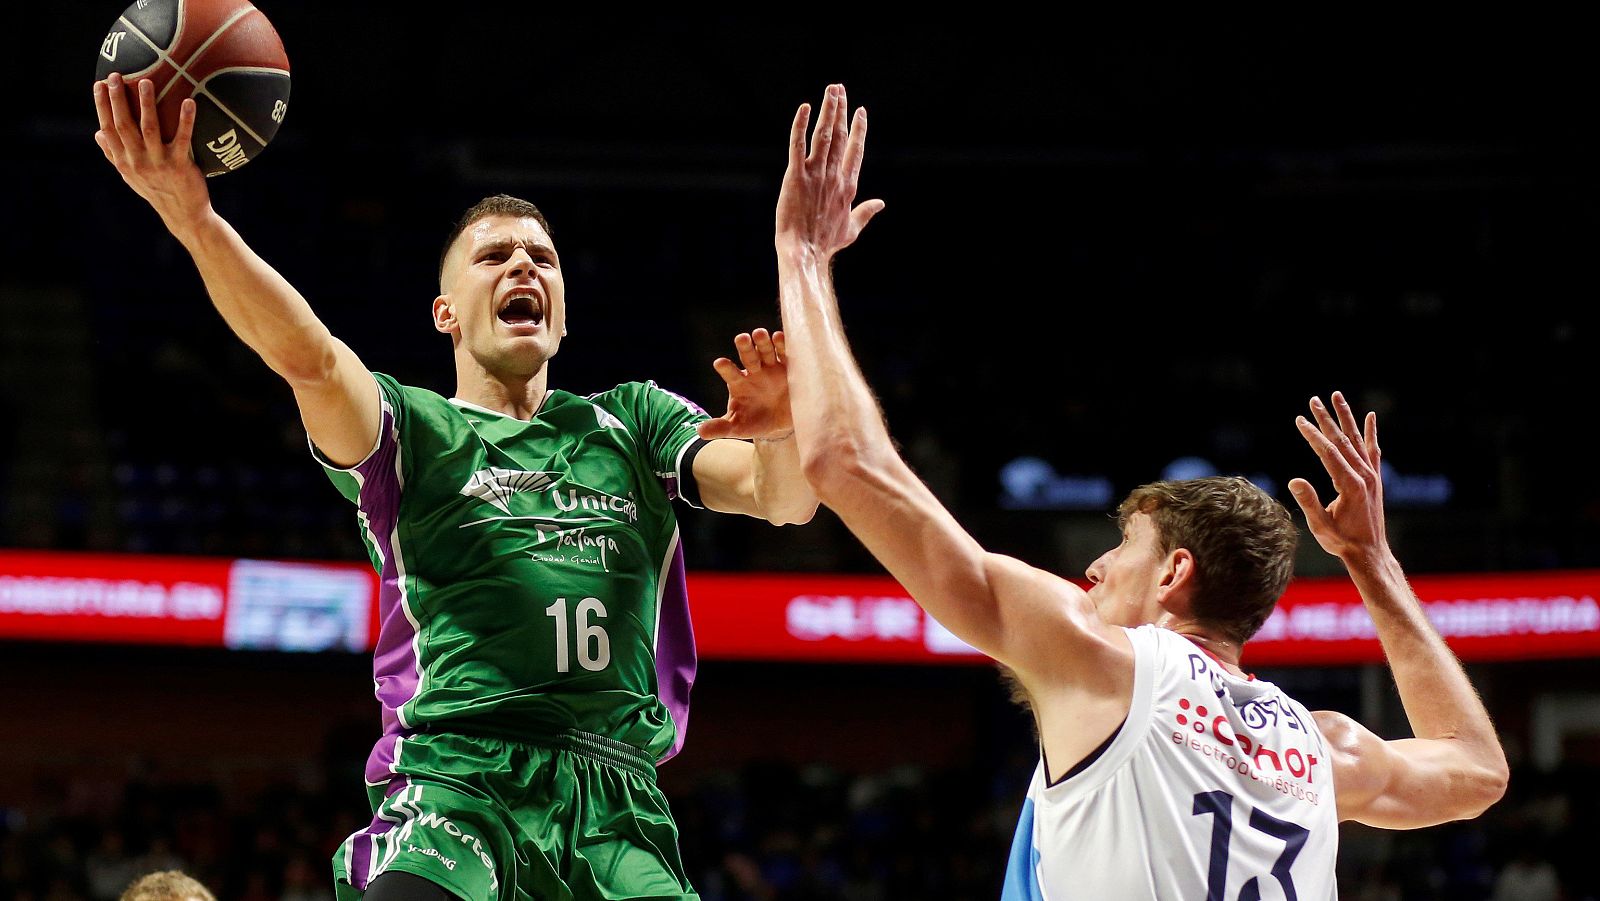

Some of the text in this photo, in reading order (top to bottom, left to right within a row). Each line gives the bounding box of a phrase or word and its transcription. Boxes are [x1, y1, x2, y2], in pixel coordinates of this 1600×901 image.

[570, 555, 600, 565] Genial
[545, 597, 611, 673] 16
[1192, 789, 1311, 901] 13
